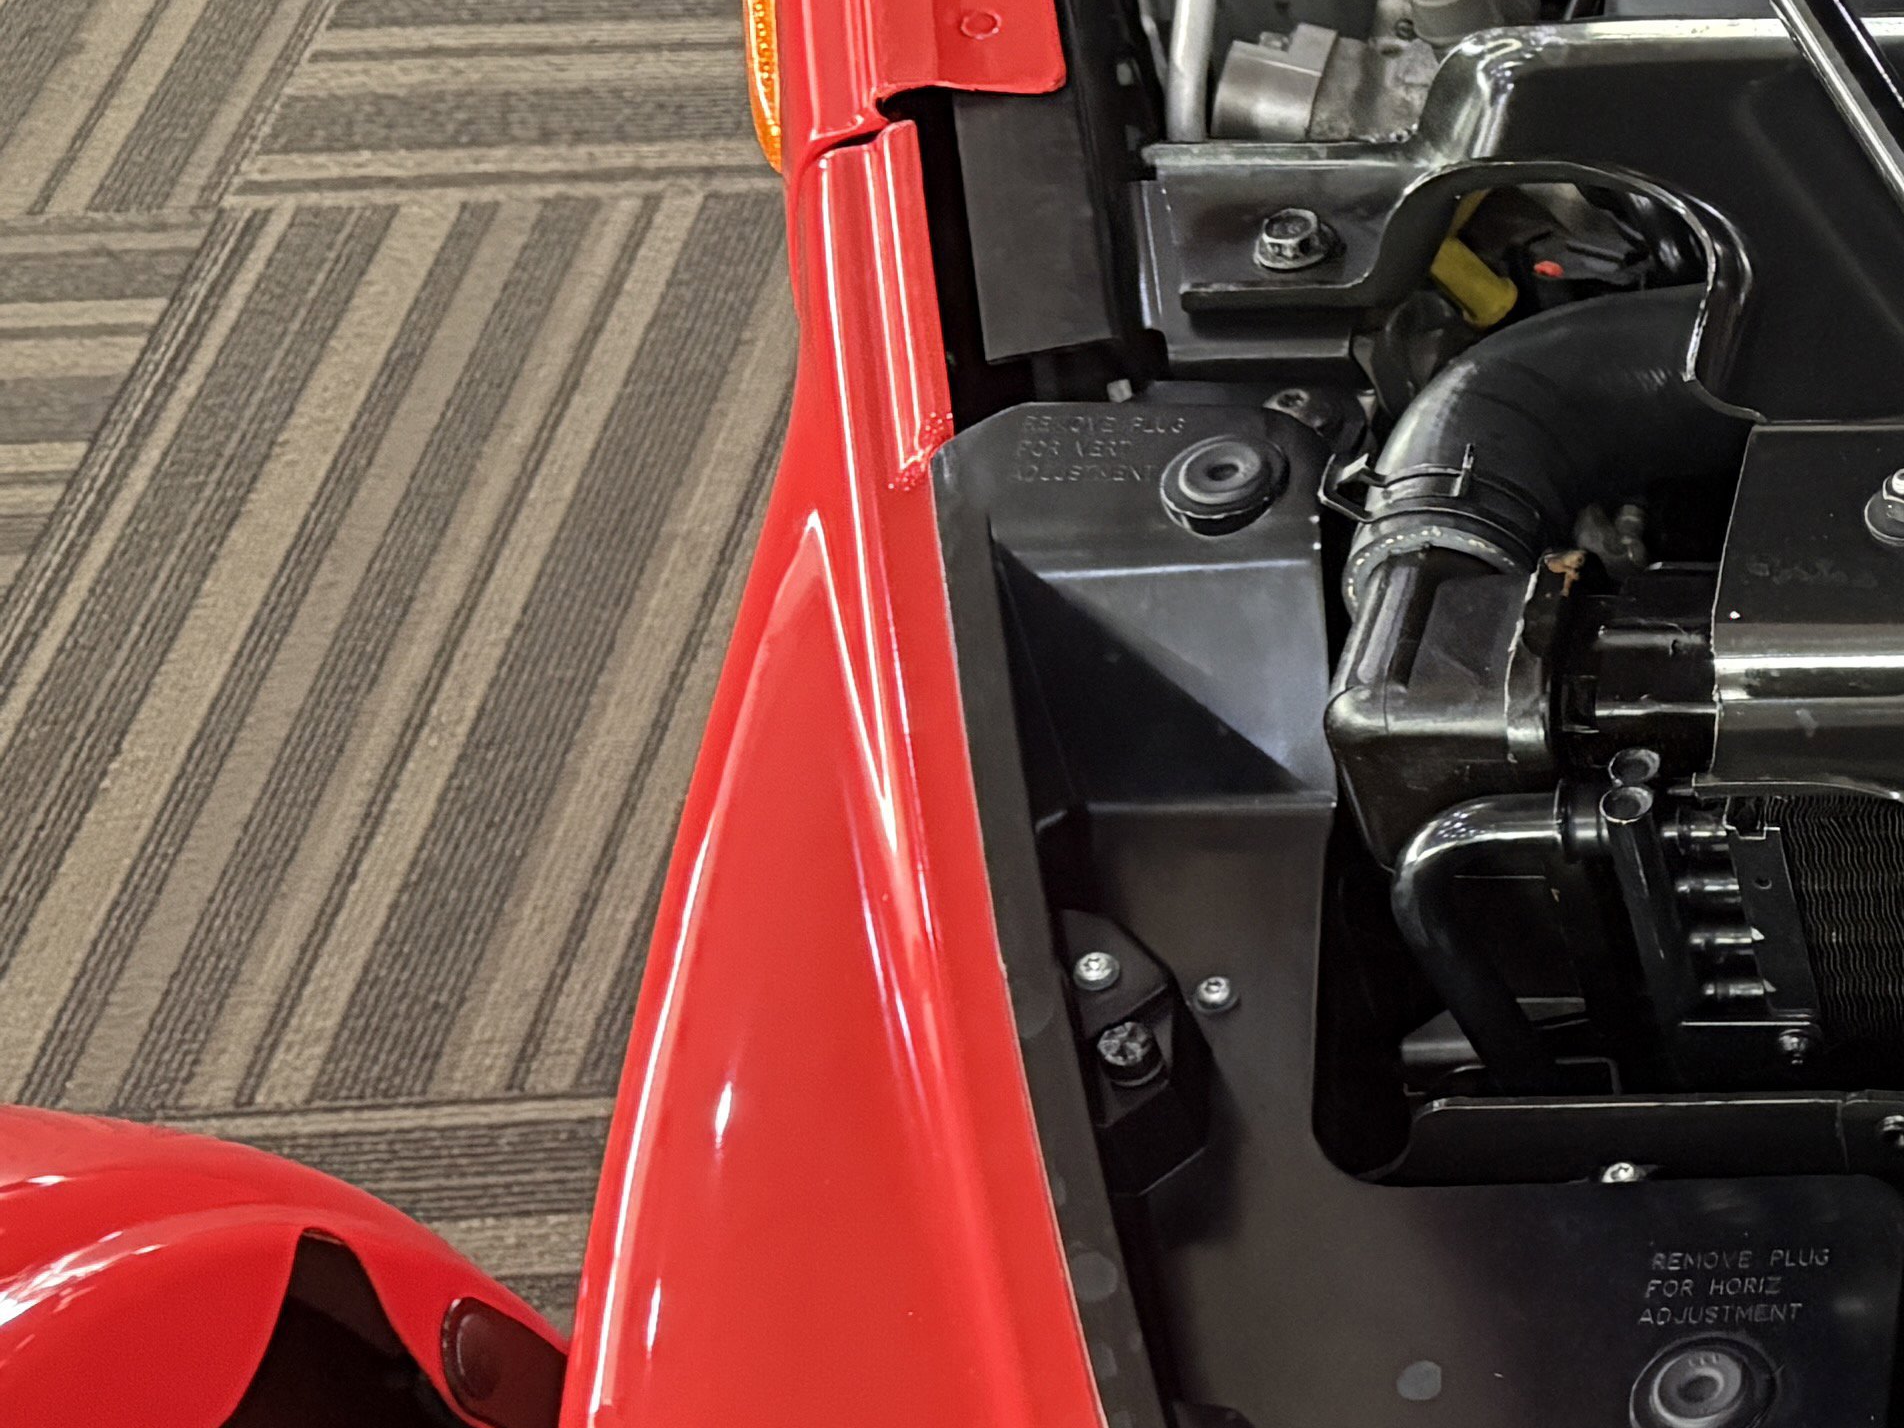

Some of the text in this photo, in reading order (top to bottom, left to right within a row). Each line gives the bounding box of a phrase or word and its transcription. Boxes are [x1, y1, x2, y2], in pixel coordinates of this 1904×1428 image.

[1652, 1248, 1830, 1271] REMOVE PLUG
[1644, 1275, 1783, 1298] FOR HORIZ
[1638, 1303, 1803, 1326] ADJUSTMENT
